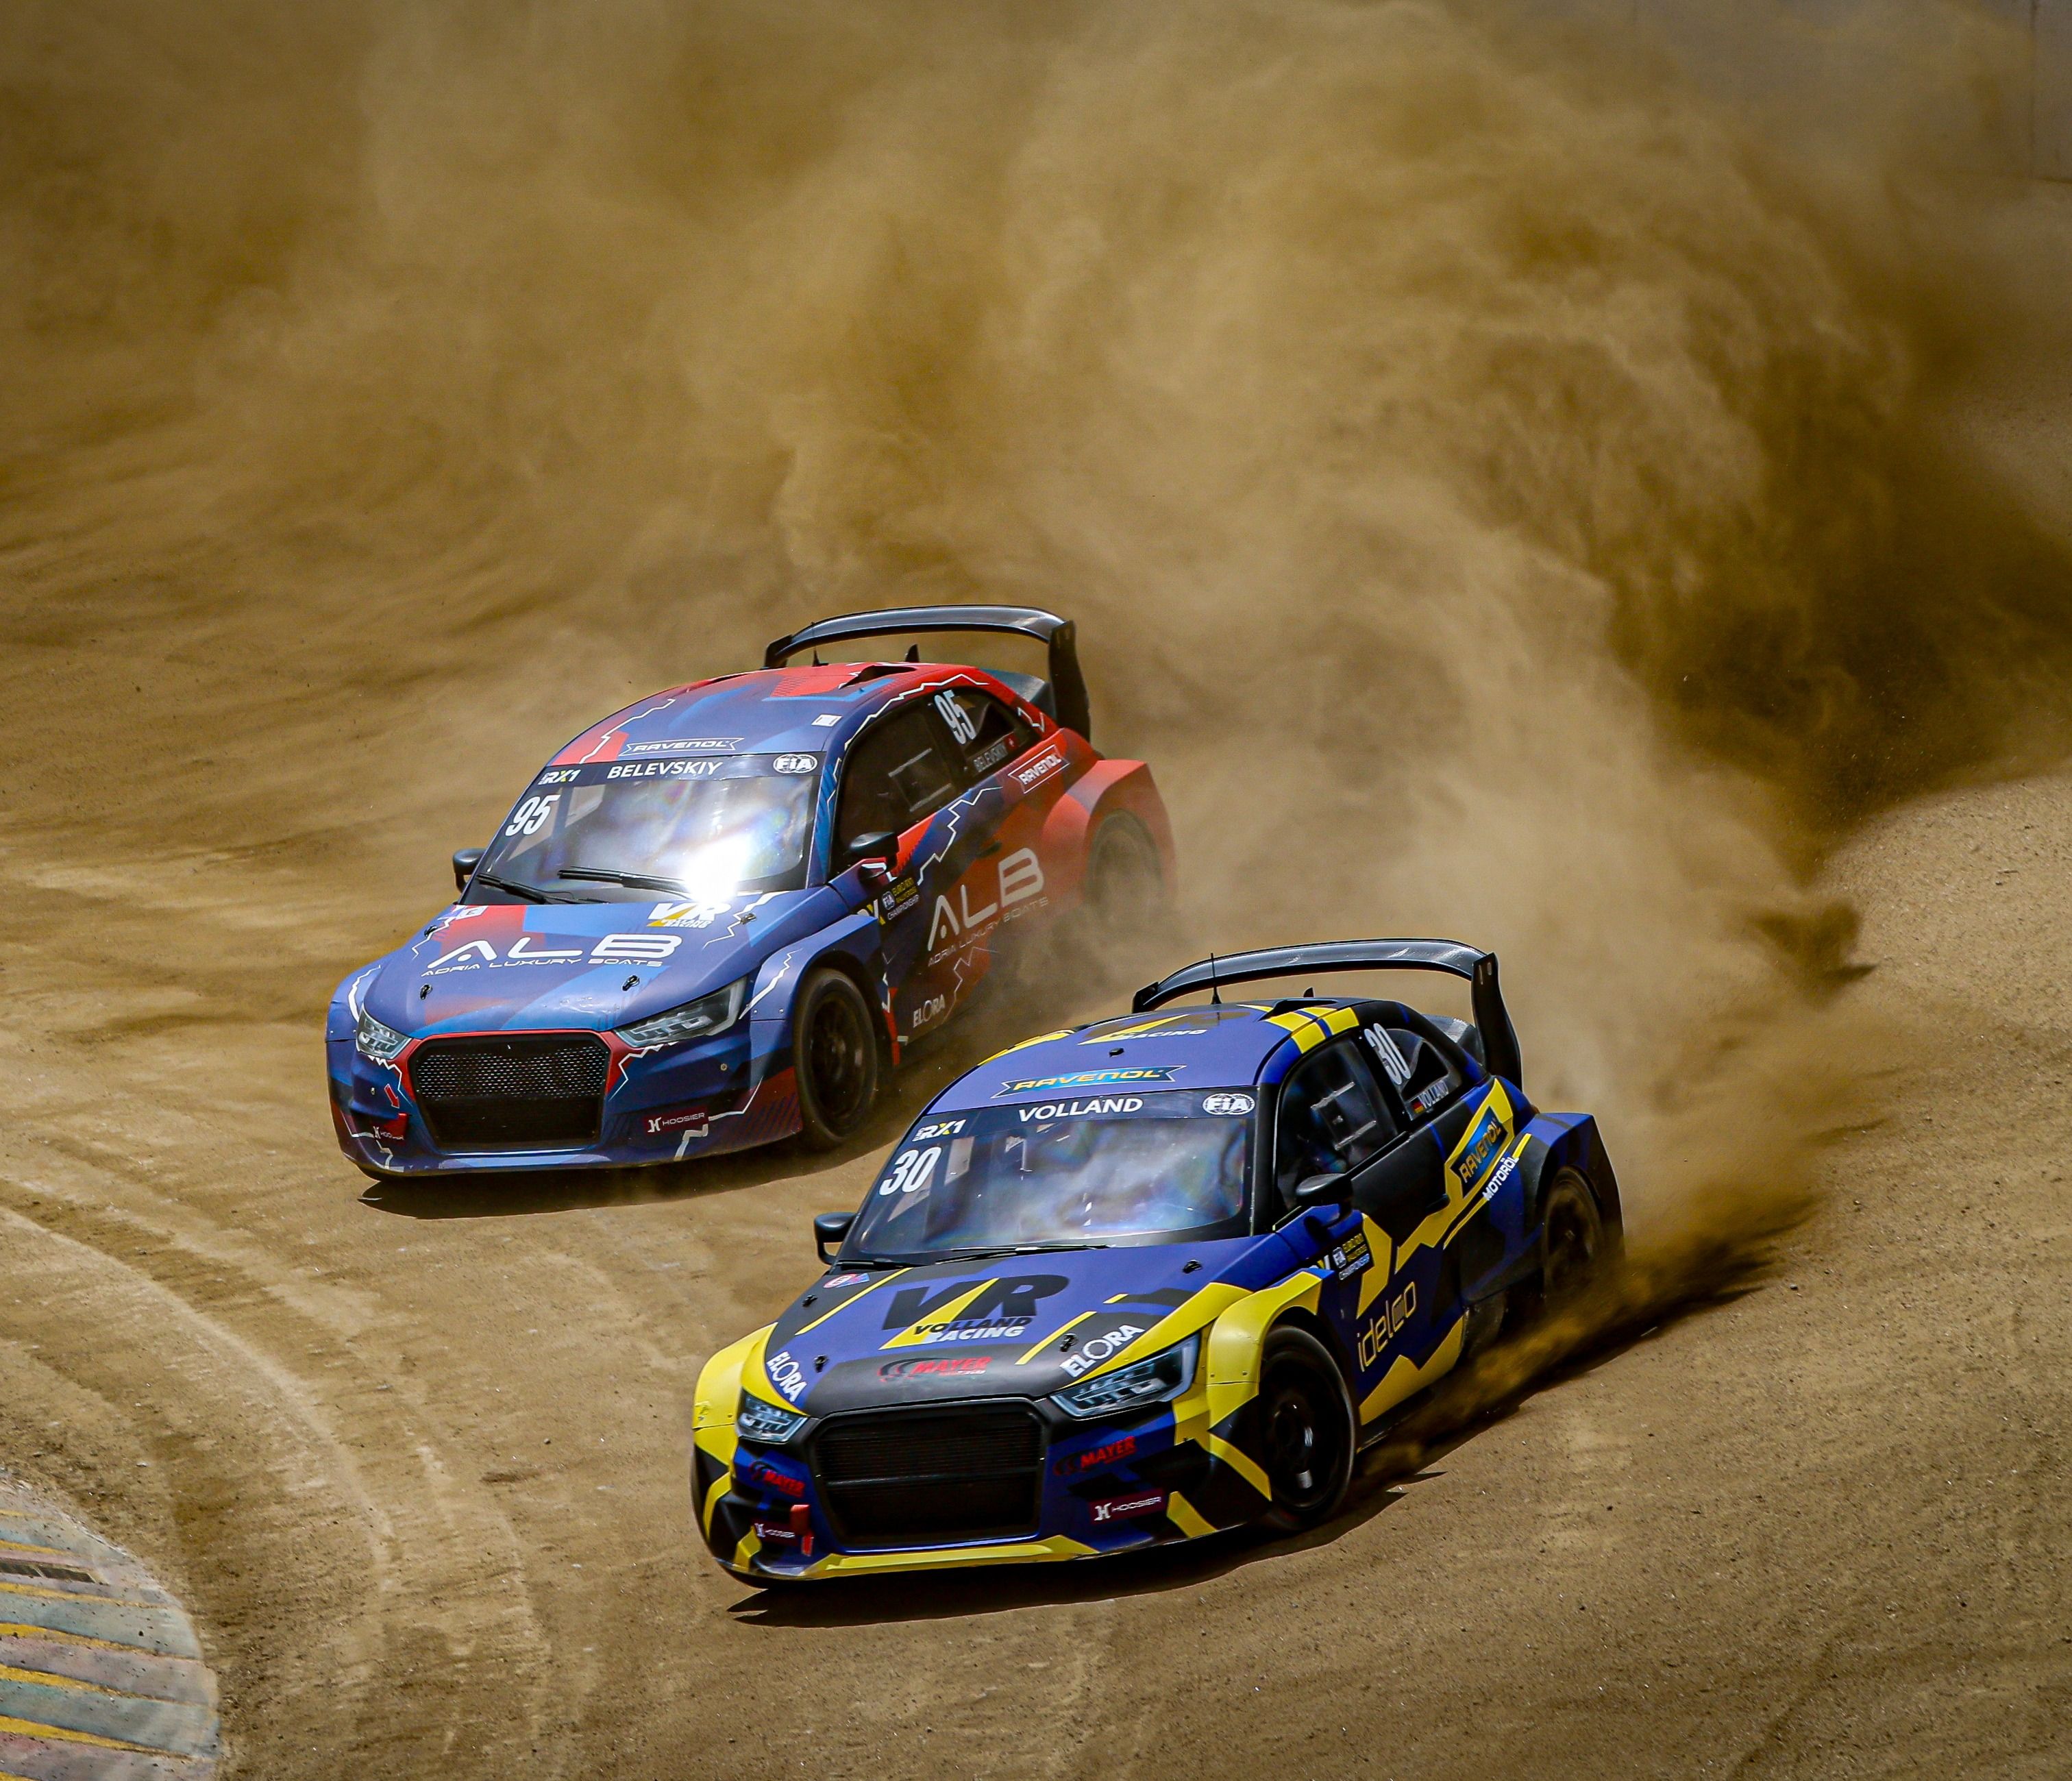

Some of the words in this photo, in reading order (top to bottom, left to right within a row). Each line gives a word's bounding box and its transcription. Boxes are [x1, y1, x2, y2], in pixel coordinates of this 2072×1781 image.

[934, 690, 976, 744] 95
[633, 740, 728, 752] RAVENOL
[539, 770, 581, 785] RX1
[607, 761, 723, 779] BELEVSKIY
[1018, 754, 1062, 785] RAVENOL
[505, 795, 561, 836] 95
[928, 847, 1044, 952] ALB
[428, 934, 682, 968] ALB
[421, 964, 480, 977] ADRIA
[489, 959, 582, 968] LUXURY
[588, 959, 663, 967] BOATS
[913, 994, 945, 1028] ELORA
[1364, 1022, 1411, 1085] 30
[1013, 1070, 1163, 1090] RAVENOL
[663, 1112, 705, 1126] HOOSIER
[1019, 1097, 1143, 1122] VOLLAND
[913, 1120, 966, 1142] RX1
[1459, 1120, 1501, 1183] RAVENOL
[879, 1146, 941, 1196] 30
[1482, 1156, 1520, 1201] MOTORÖL
[881, 1275, 1070, 1330] VR
[914, 1316, 1033, 1335] VOLLAND
[926, 1326, 1026, 1343] RACING
[1357, 1281, 1416, 1373] idelco
[910, 1356, 992, 1376] MAYER
[1059, 1325, 1146, 1377] ELORA
[766, 1351, 807, 1402] ELORA
[1081, 1436, 1135, 1469] MAYER
